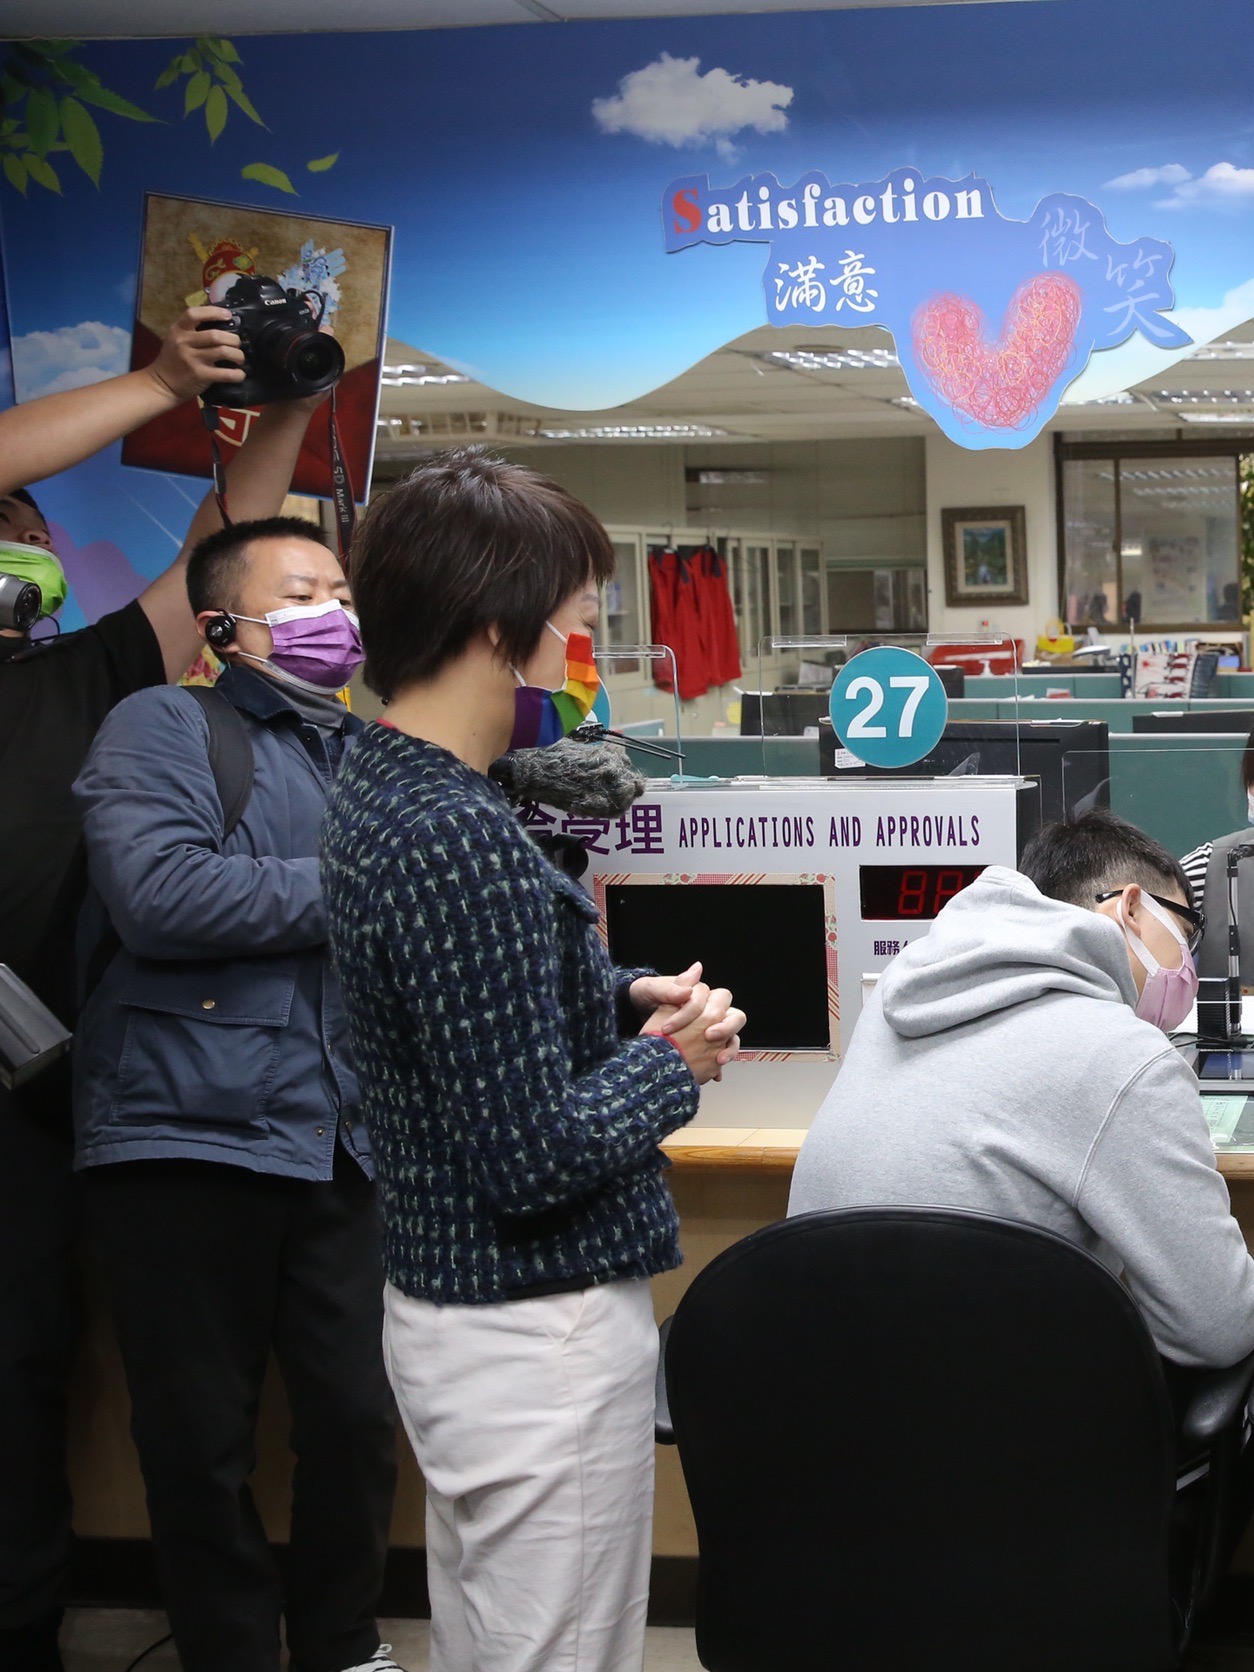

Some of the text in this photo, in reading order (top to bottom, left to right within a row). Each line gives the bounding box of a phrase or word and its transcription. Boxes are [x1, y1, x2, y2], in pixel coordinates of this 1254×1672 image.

[672, 177, 985, 234] Satisfaction
[264, 298, 287, 306] Canon
[774, 250, 879, 314] 滿意
[1040, 207, 1177, 340] 微笑
[845, 676, 930, 739] 27
[679, 816, 815, 849] APPLICATIONS
[829, 816, 861, 848] AND
[877, 815, 981, 848] APPROVALS
